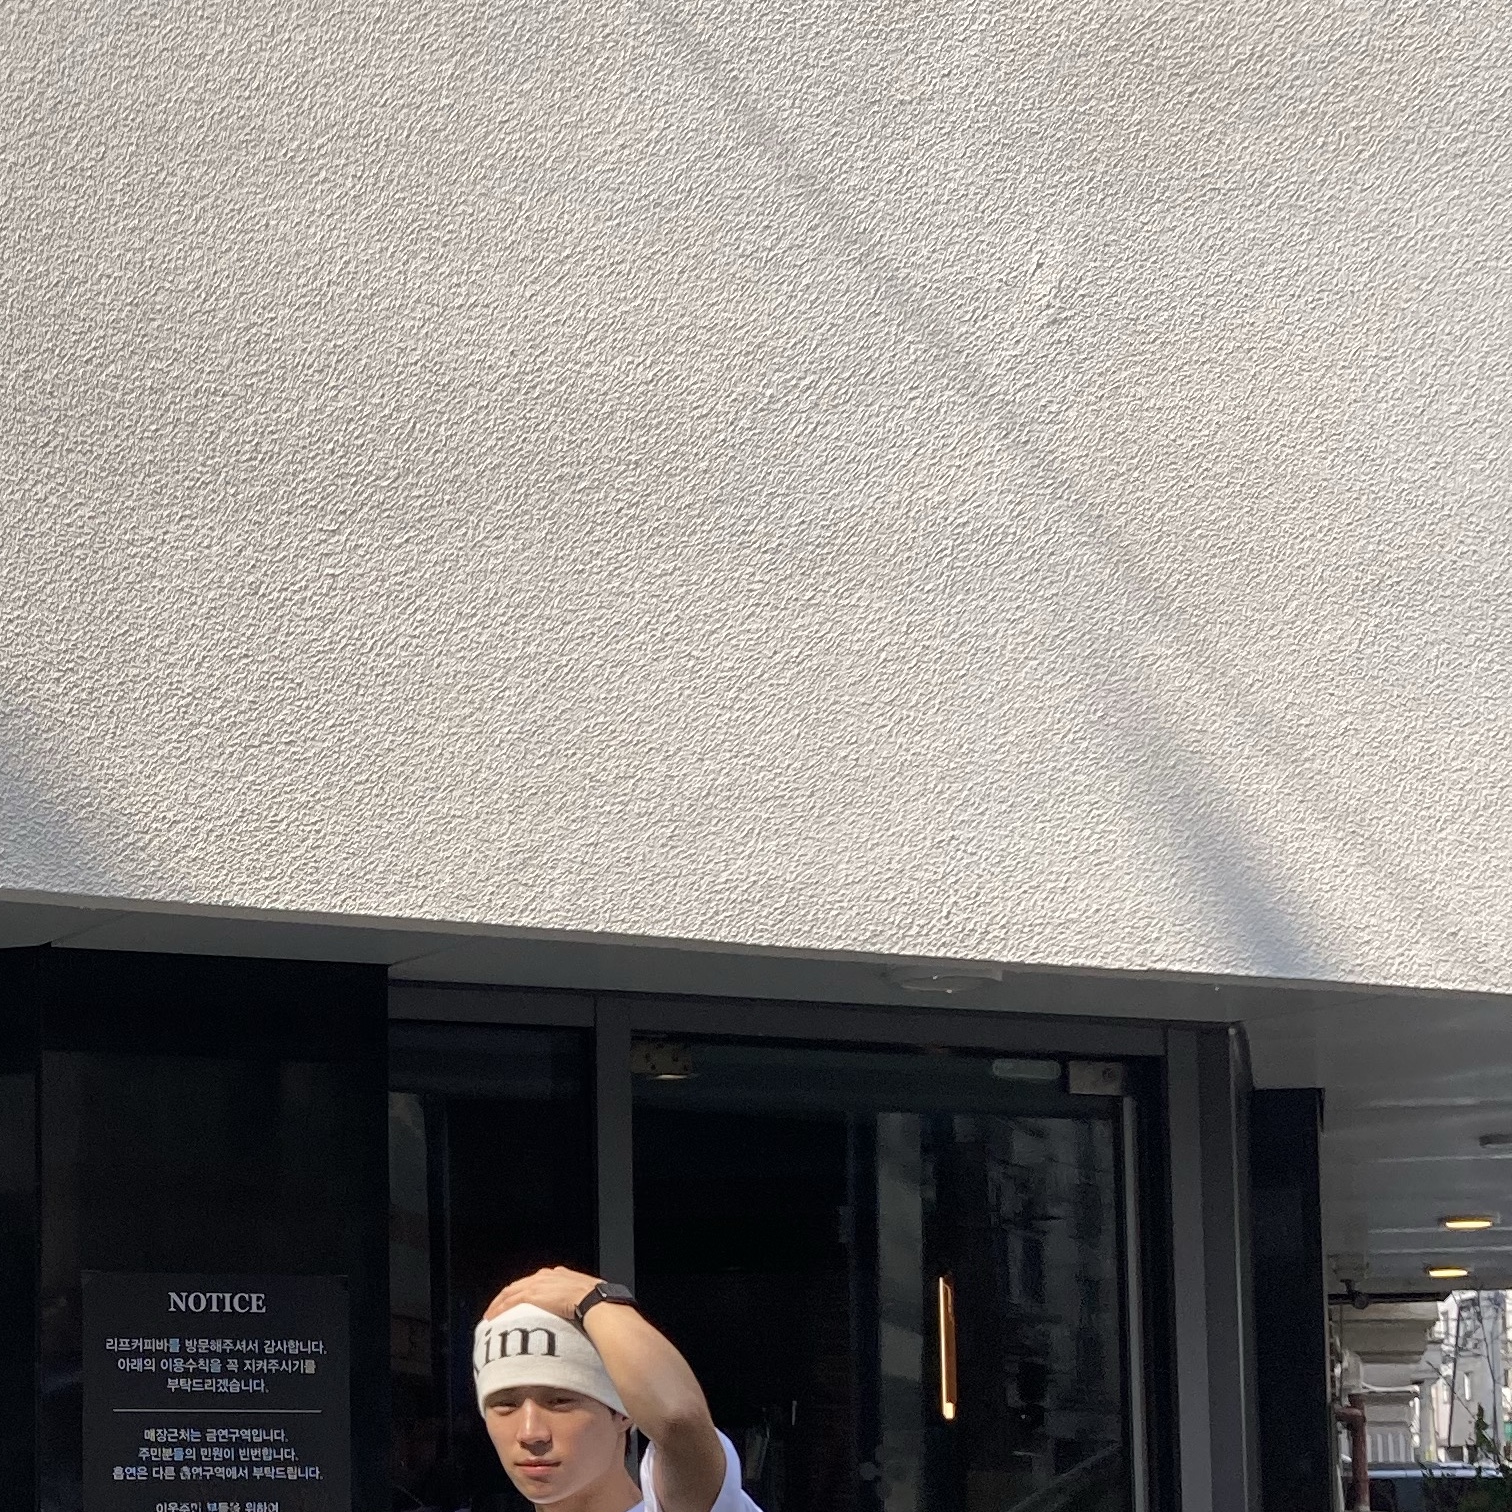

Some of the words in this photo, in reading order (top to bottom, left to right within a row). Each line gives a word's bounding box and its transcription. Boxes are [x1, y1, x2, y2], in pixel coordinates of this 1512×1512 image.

[168, 1291, 267, 1313] NOTICE
[105, 1337, 181, 1353] 리프커피바를
[184, 1338, 259, 1354] 방문해주셔서
[263, 1339, 327, 1355] 감사합니다.
[117, 1357, 156, 1373] 아래의
[160, 1357, 222, 1373] 이용수칙을
[226, 1358, 239, 1373] 꼭
[243, 1358, 317, 1374] 지켜주시기를
[166, 1377, 270, 1393] 부탁드리겠습니다.
[143, 1428, 202, 1443] 매장근처는
[205, 1428, 289, 1443] 금연구역입니다.
[138, 1447, 197, 1462] 주민분들의
[200, 1446, 235, 1462] 민원이
[238, 1446, 299, 1462] 빈번합니다.
[112, 1466, 149, 1481] 흡연은
[152, 1466, 176, 1481] 다른
[252, 1465, 325, 1480] 부탁드립니다.
